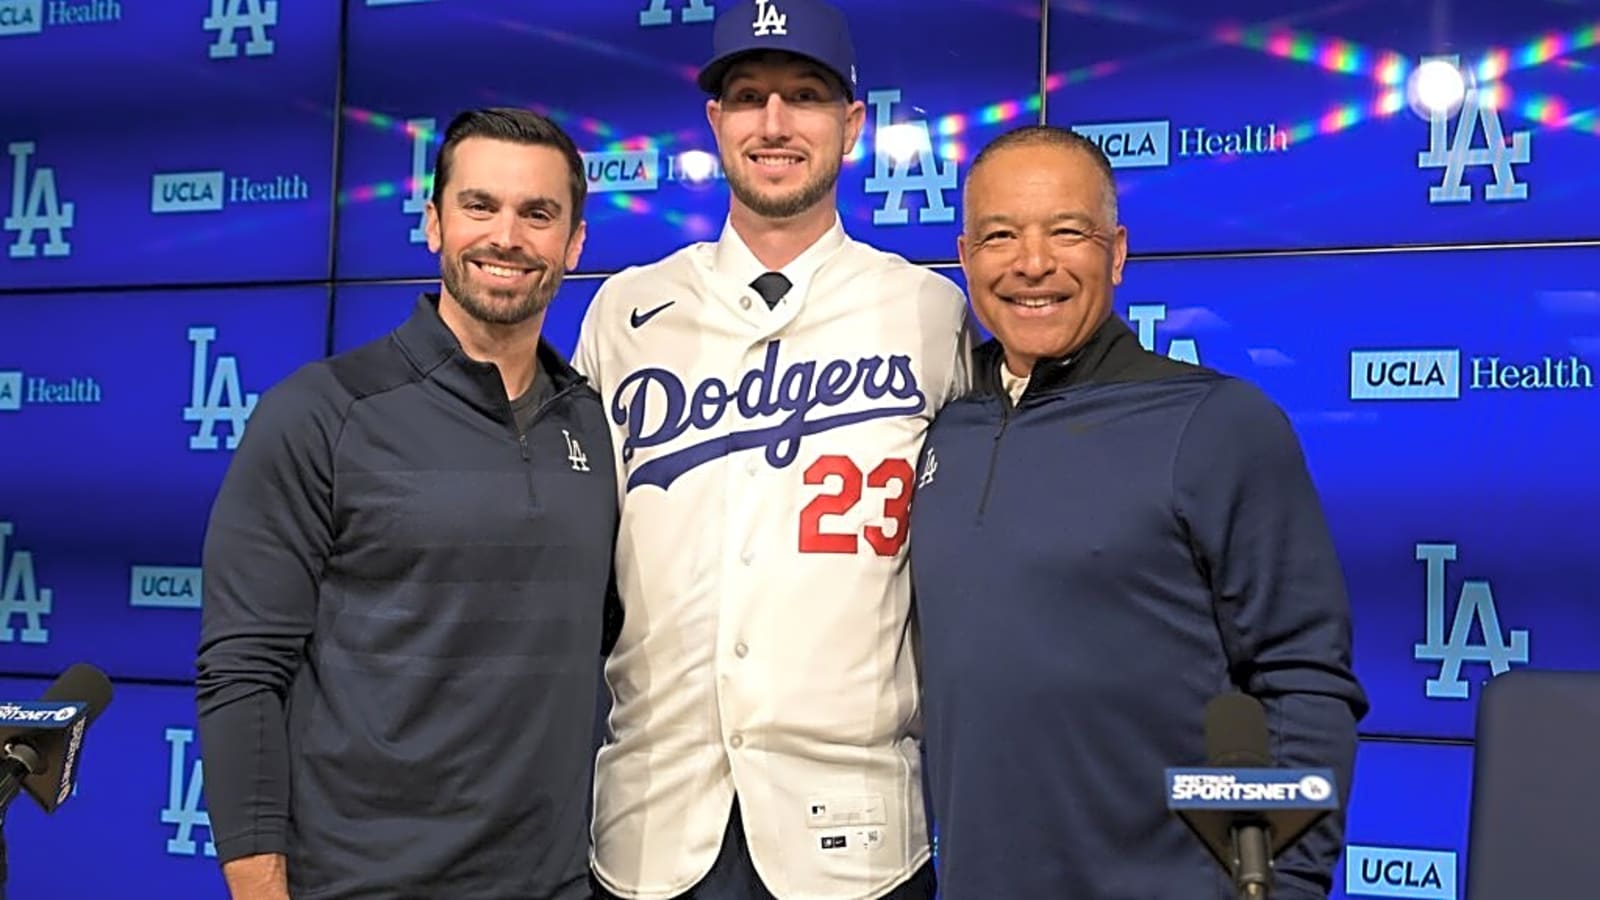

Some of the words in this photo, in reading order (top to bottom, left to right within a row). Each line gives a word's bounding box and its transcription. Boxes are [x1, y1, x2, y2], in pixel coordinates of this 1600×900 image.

[0, 7, 34, 26] CLA
[48, 0, 121, 25] Health
[753, 0, 787, 36] LA
[1178, 123, 1288, 156] Health
[1418, 54, 1530, 203] LA
[588, 159, 648, 182] UCLA
[865, 90, 957, 225] LA
[162, 181, 215, 203] UCLA
[230, 174, 309, 202] Health
[403, 118, 435, 243] L
[4, 142, 74, 257] LA
[27, 377, 101, 402] Health
[184, 327, 259, 450] LA
[1366, 361, 1446, 387] UCLA
[1469, 355, 1594, 389] Health
[611, 339, 922, 469] Dodgers
[562, 429, 590, 472] LA
[798, 454, 916, 557] 23
[142, 576, 194, 598] UCLA
[1415, 543, 1529, 699] LA
[1171, 783, 1301, 801] SPORTSNET
[1362, 858, 1443, 890] UCLA
